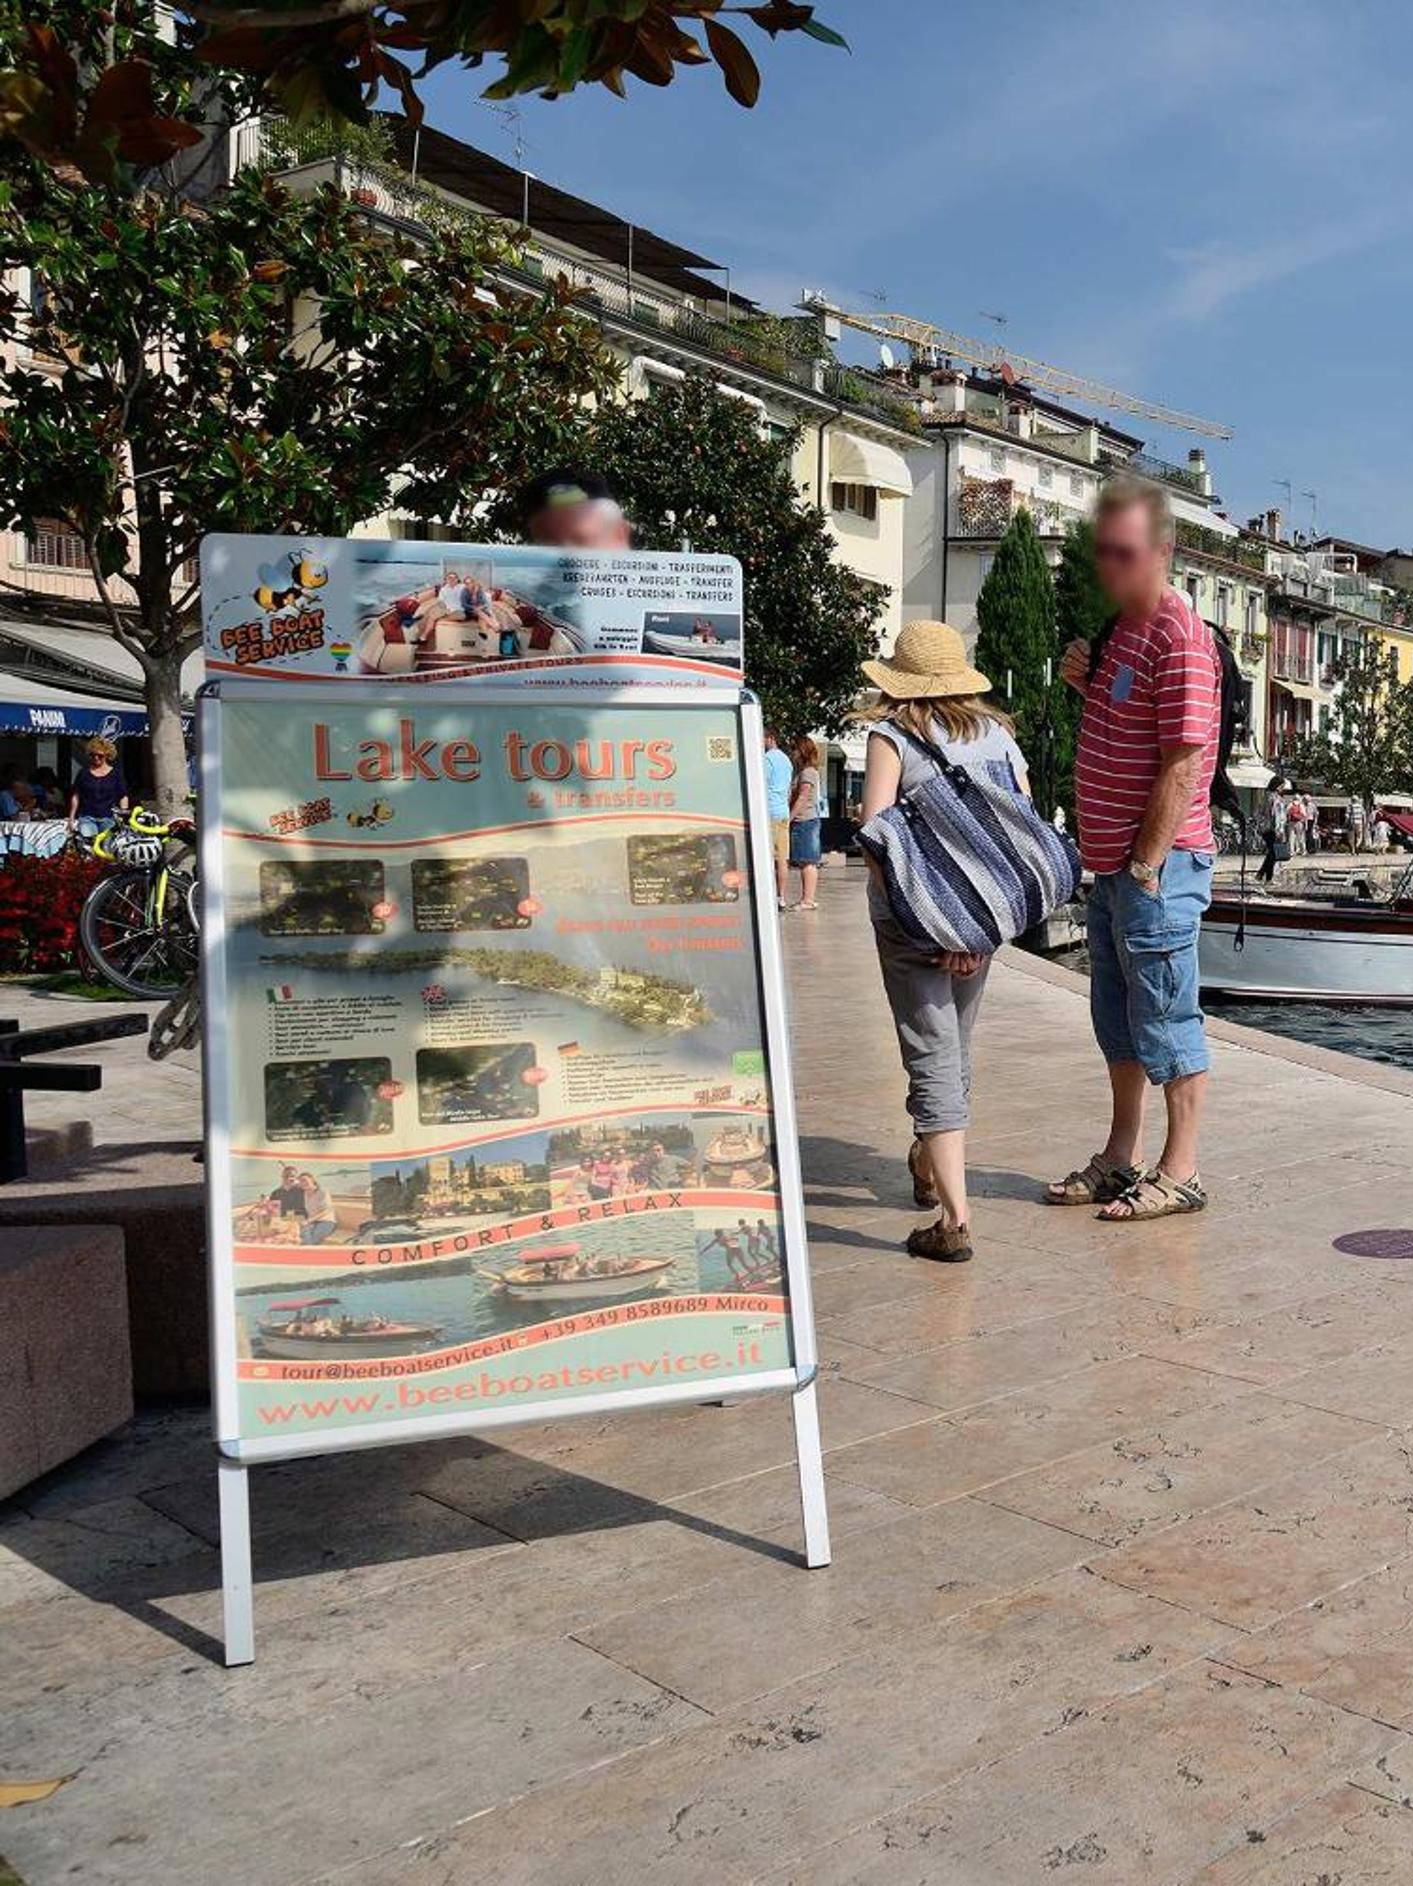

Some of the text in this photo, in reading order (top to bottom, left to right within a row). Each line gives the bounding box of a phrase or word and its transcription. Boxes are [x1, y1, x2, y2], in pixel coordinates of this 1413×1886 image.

[221, 608, 325, 649] BEE BOAT
[235, 629, 325, 665] SERVICE
[313, 718, 677, 782] Lake tours
[553, 786, 677, 809] transfers
[351, 1192, 683, 1266] COMFORT & RELAX
[281, 1297, 768, 1380] tour@beeboatservice.it +39 349 8589689 Mirco
[257, 1340, 763, 1425] www.beeboatservice.it
